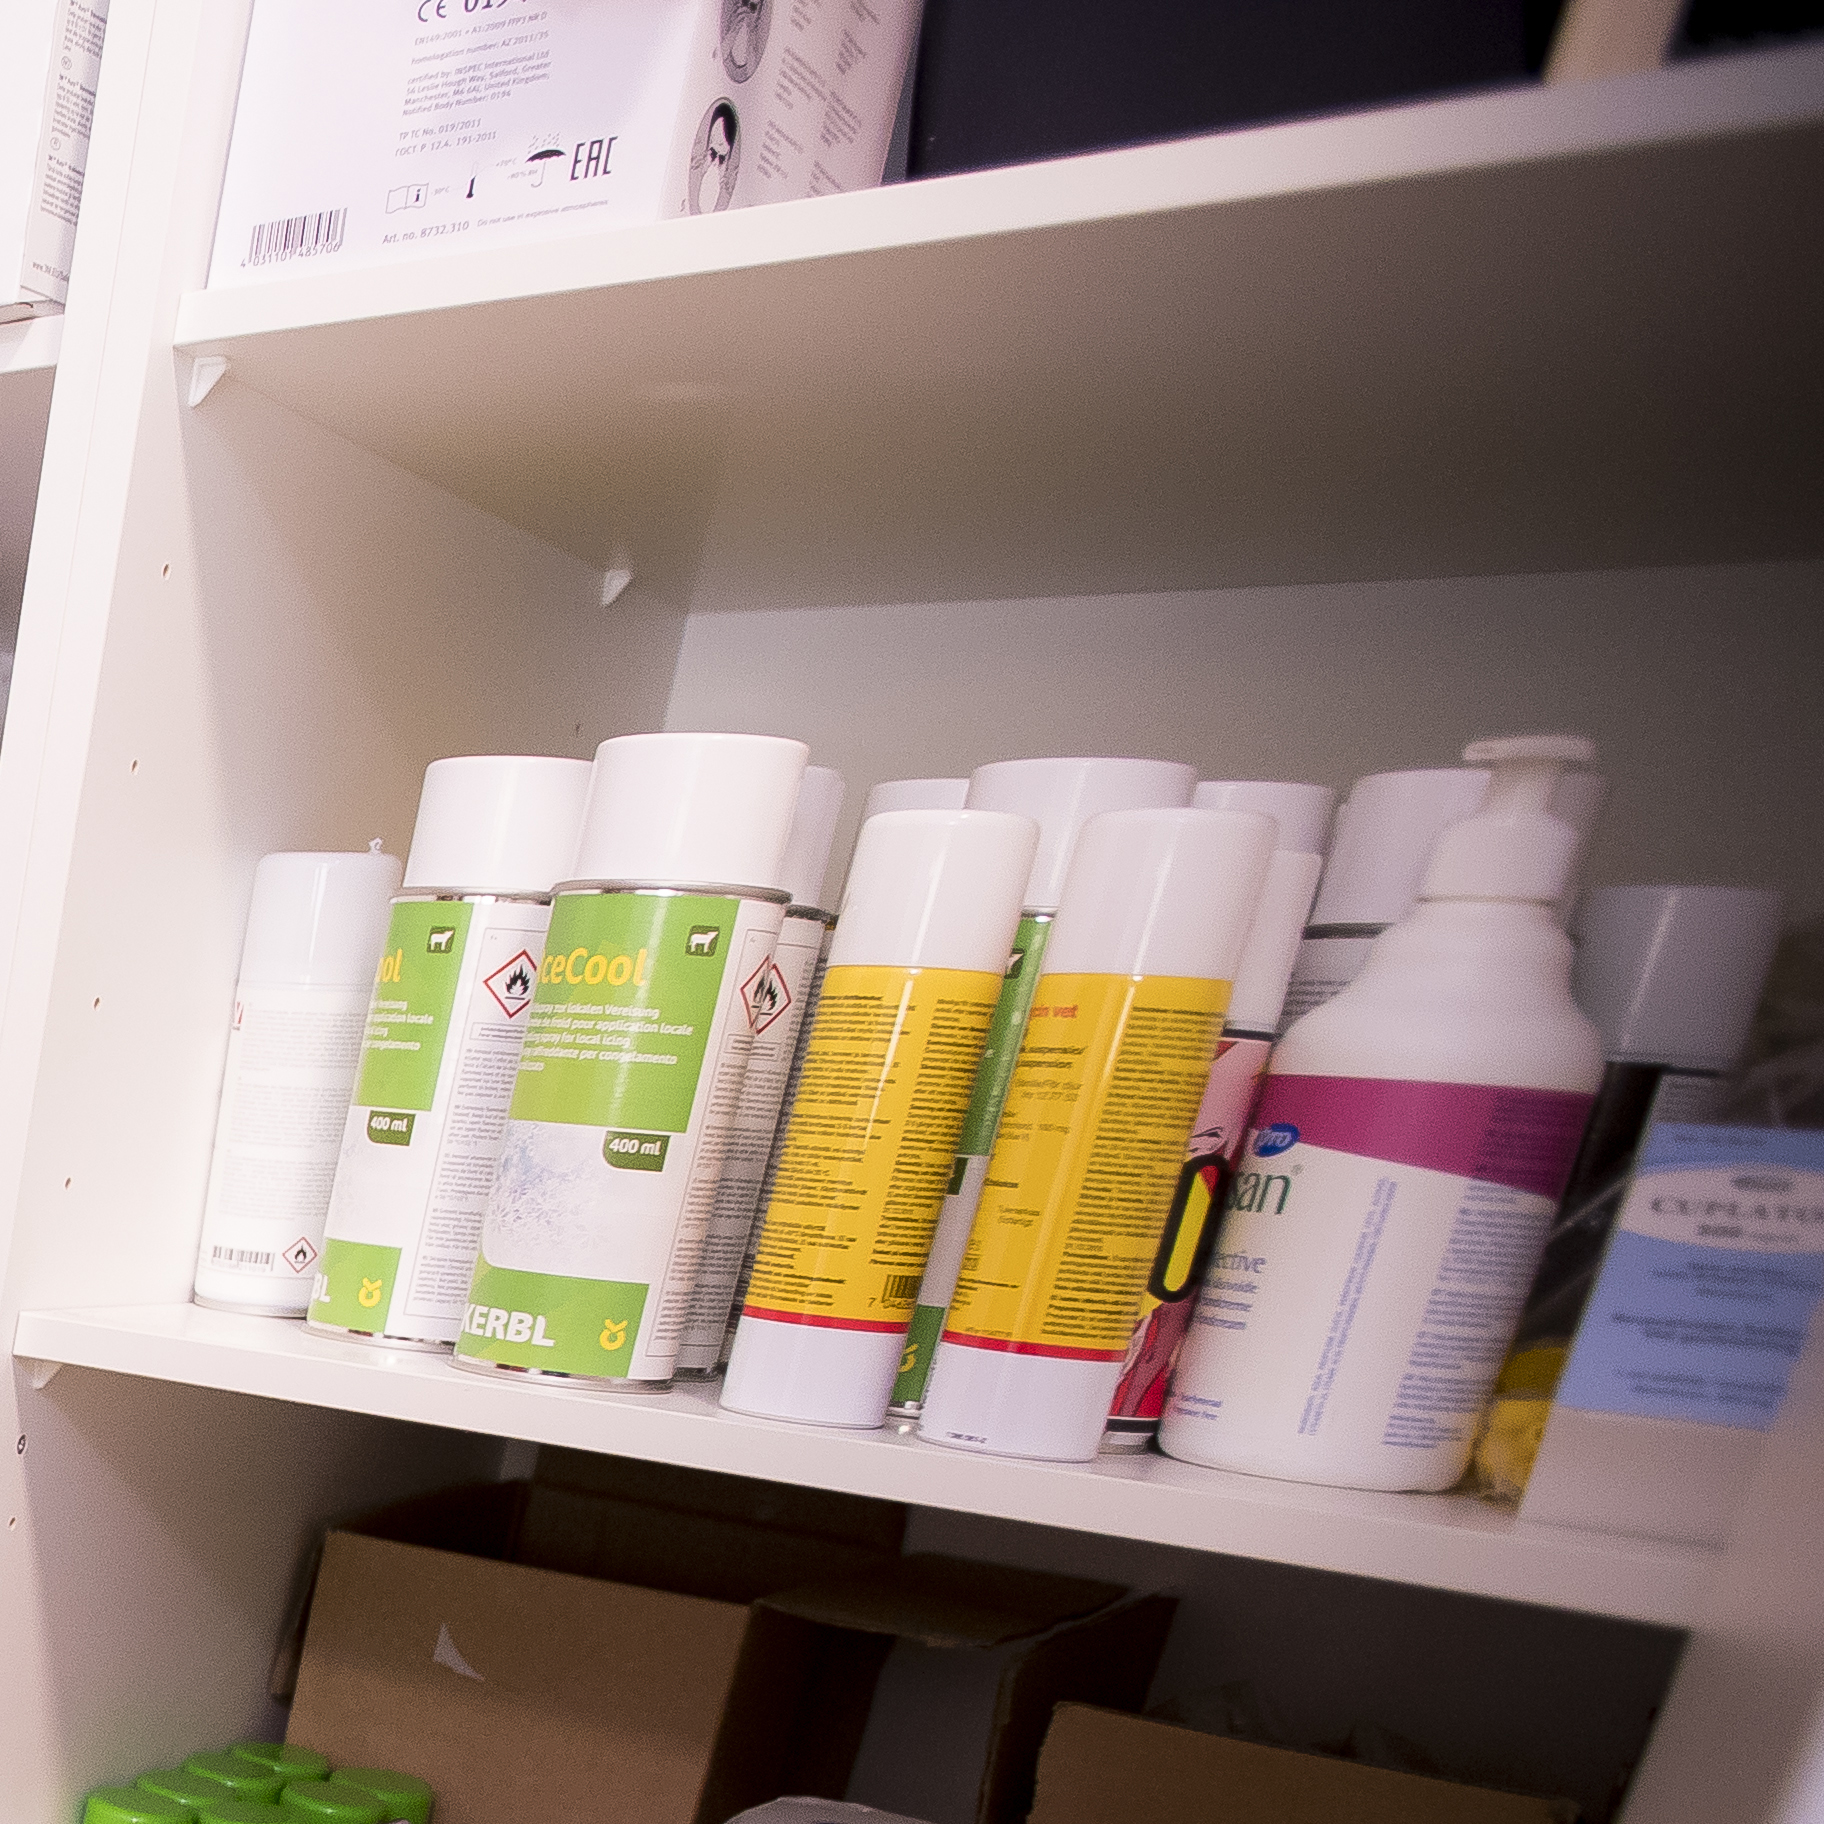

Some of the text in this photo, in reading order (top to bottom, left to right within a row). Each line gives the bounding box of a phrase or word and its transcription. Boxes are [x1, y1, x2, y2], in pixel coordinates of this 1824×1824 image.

[569, 136, 618, 181] EAC
[382, 220, 470, 245] Art. no. 8732.310
[597, 1019, 659, 1034] application
[660, 1022, 694, 1036] locale
[576, 1032, 601, 1045] local
[602, 1033, 632, 1049] icing
[370, 1116, 408, 1132] 400 ml
[609, 1137, 661, 1156] 400 ml
